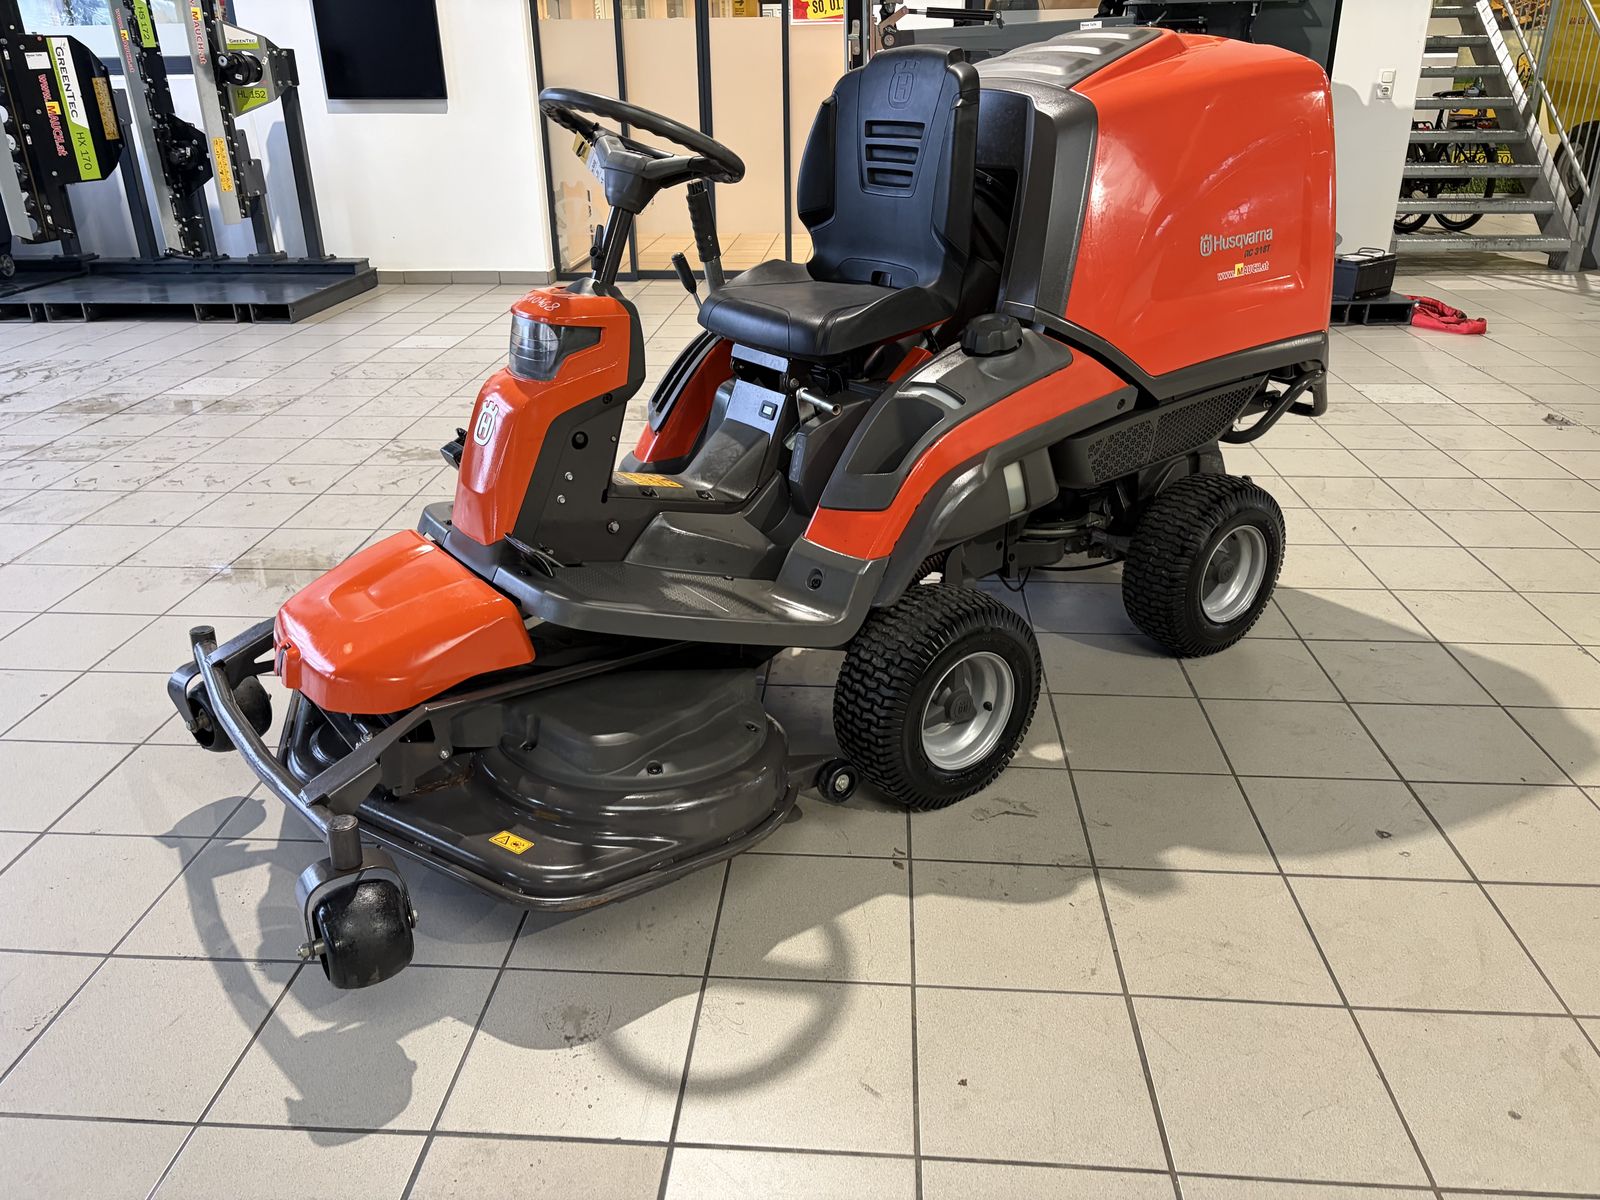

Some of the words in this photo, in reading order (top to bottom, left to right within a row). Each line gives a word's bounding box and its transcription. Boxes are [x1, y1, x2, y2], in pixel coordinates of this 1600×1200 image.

[141, 24, 151, 40] 172
[237, 90, 248, 99] HL
[250, 90, 266, 99] 152
[76, 132, 87, 147] HX
[80, 151, 92, 171] 170
[1213, 228, 1273, 252] Husqvarna
